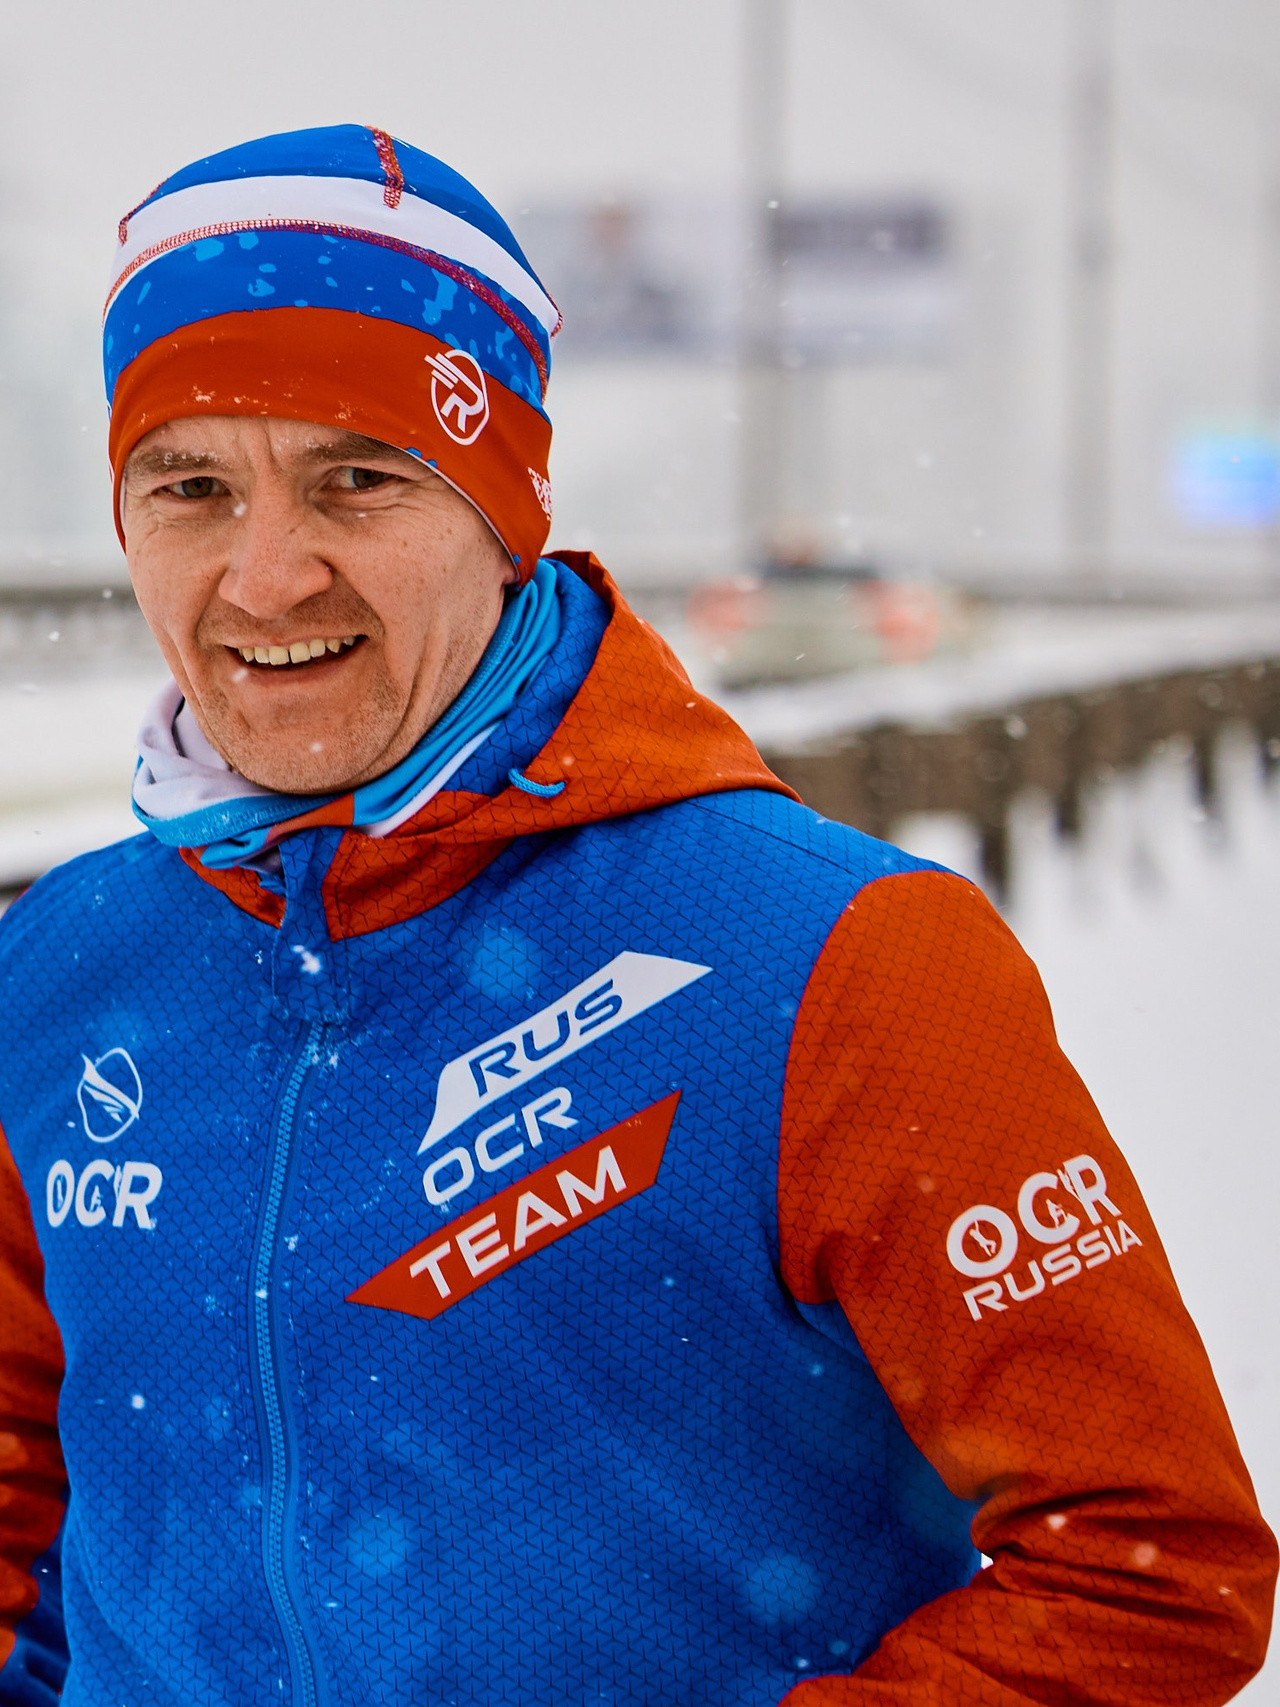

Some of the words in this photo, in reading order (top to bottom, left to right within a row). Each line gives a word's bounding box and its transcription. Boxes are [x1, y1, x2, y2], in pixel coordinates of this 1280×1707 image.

[467, 977, 623, 1099] RUS
[46, 1159, 163, 1230] OCR
[422, 1086, 580, 1206] OCR
[408, 1144, 628, 1300] TEAM
[946, 1153, 1122, 1279] OCR
[962, 1218, 1144, 1322] RUSSIA
